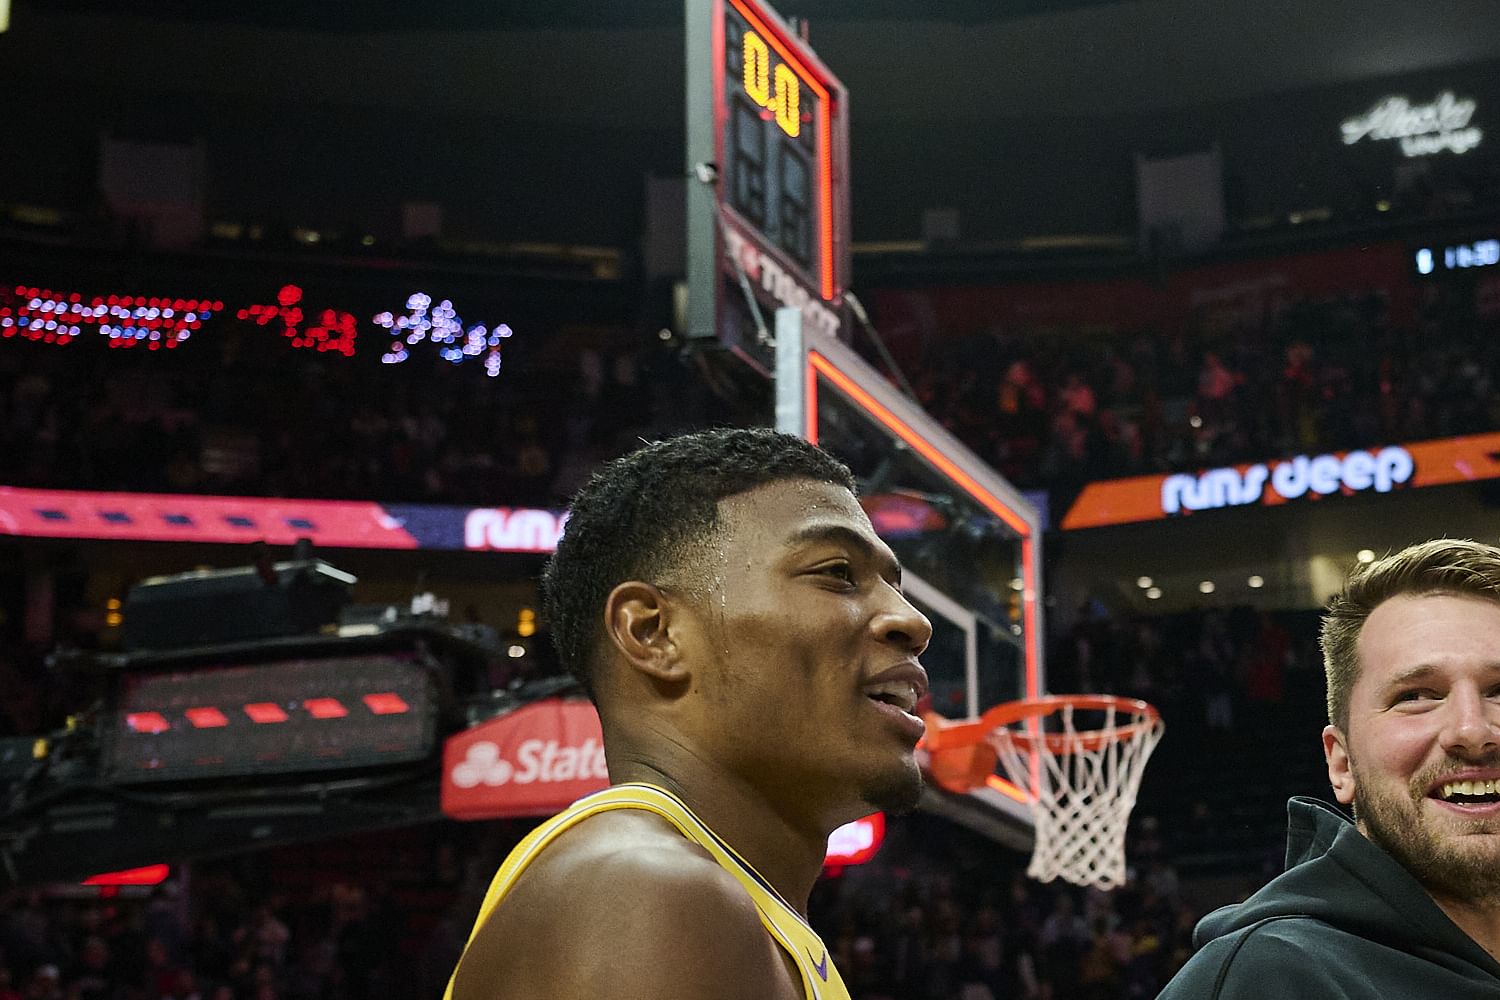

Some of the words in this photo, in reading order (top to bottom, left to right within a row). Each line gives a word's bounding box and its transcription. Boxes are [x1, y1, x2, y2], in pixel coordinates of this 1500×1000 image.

[743, 31, 799, 137] 0.0
[1161, 463, 1269, 514] runs
[1271, 445, 1414, 499] deep
